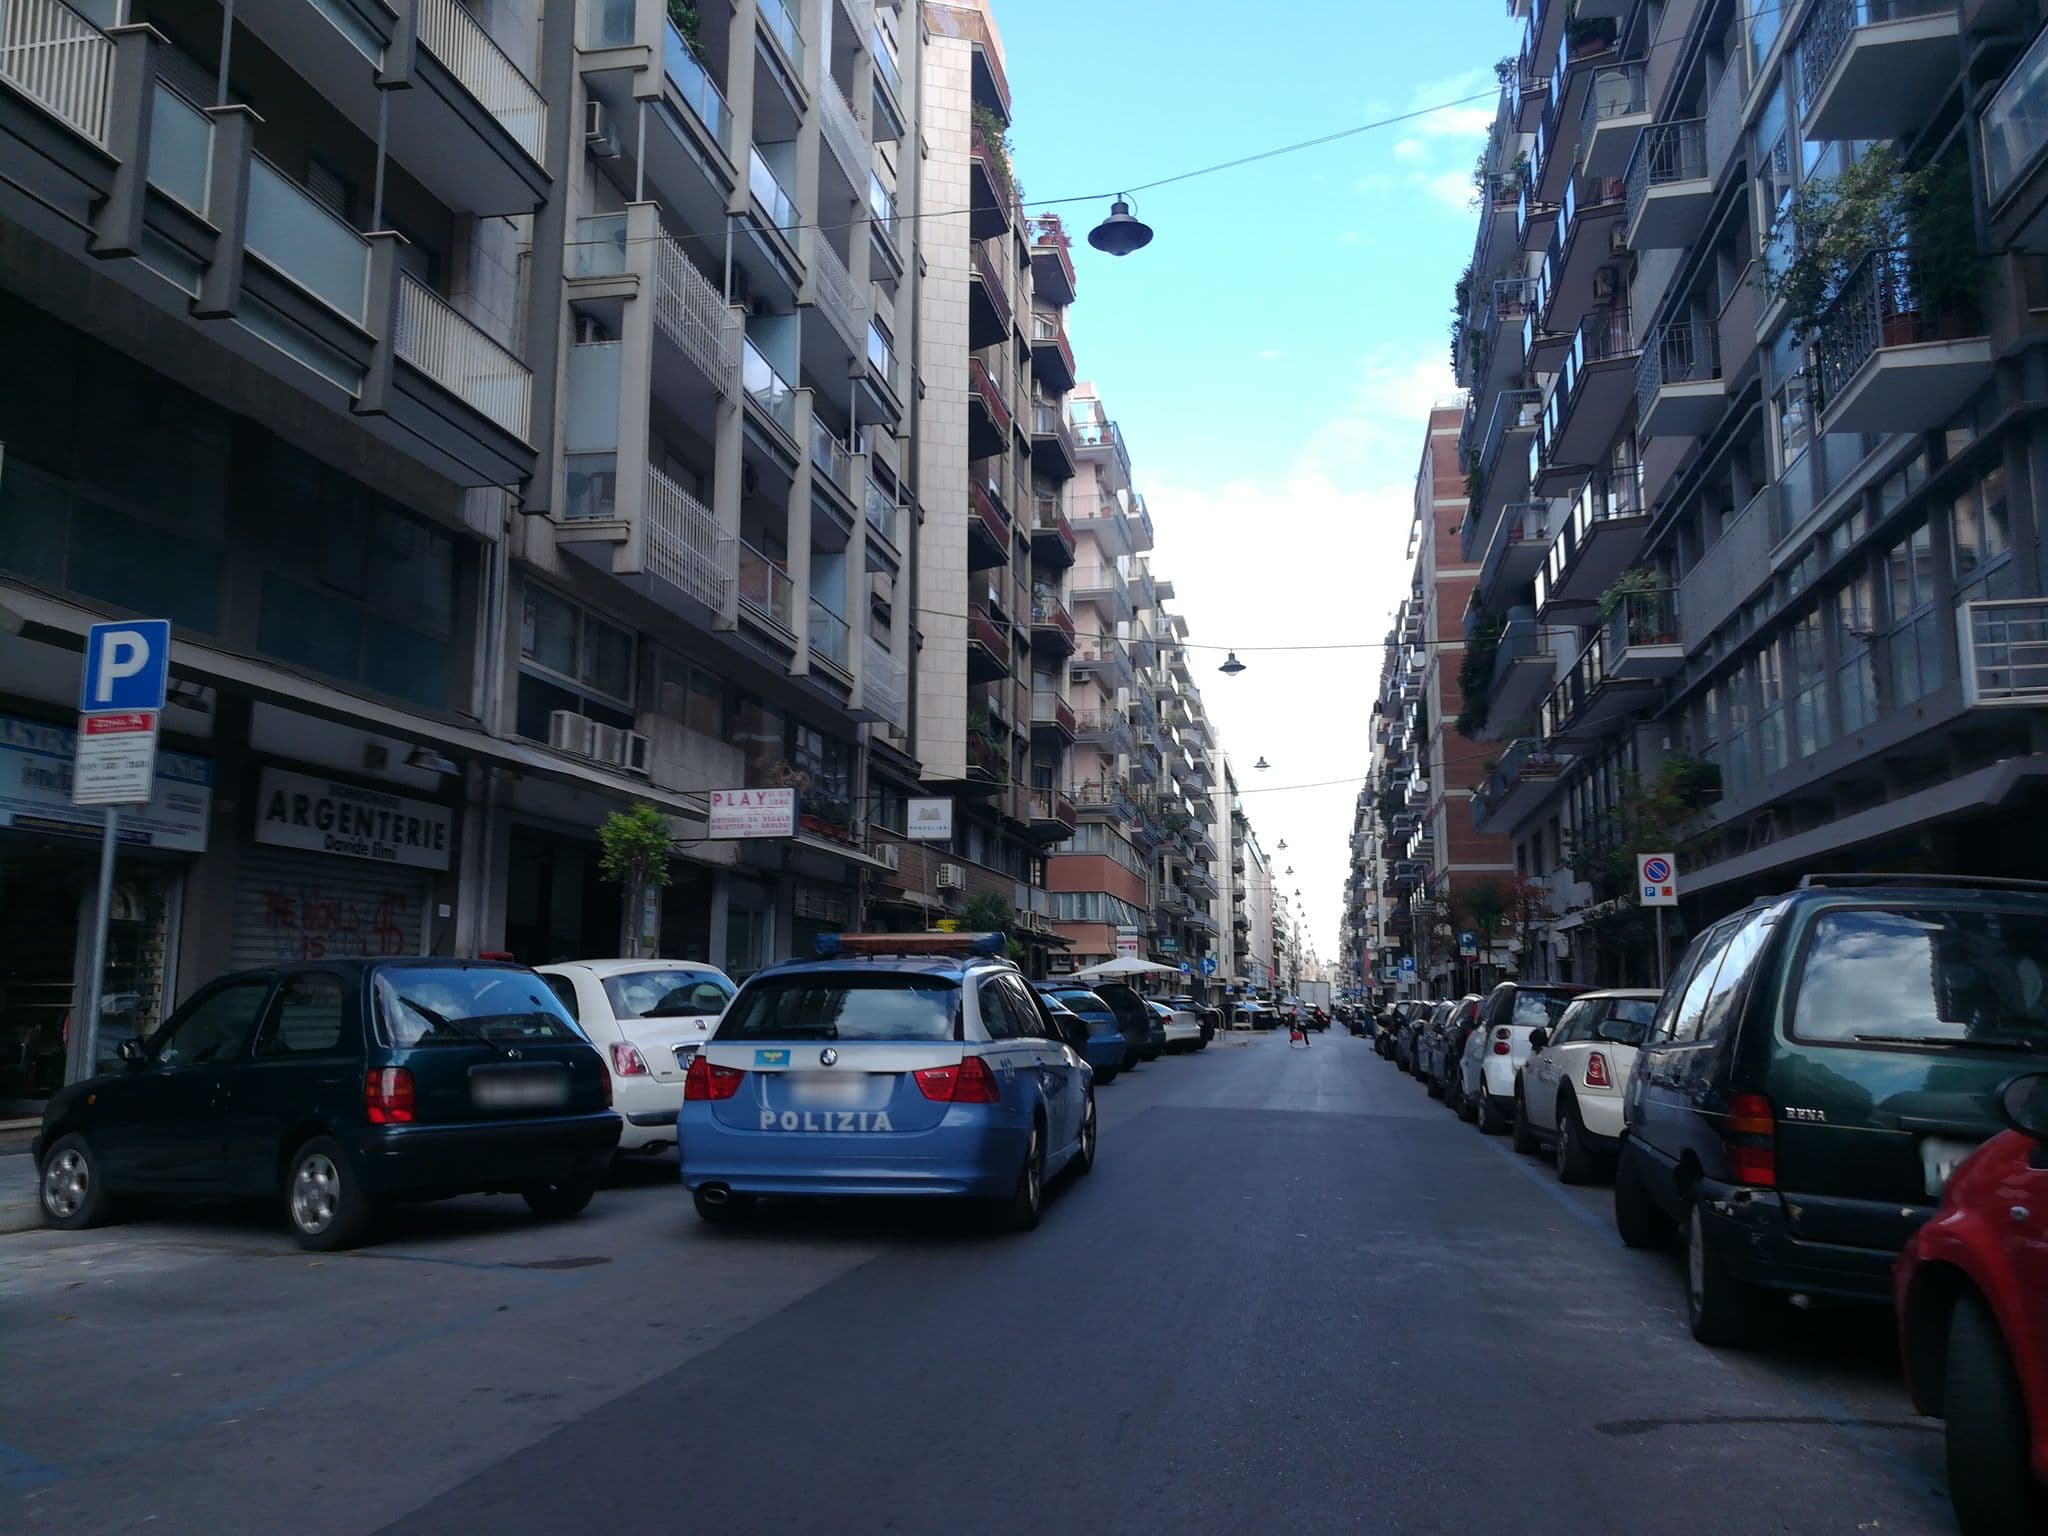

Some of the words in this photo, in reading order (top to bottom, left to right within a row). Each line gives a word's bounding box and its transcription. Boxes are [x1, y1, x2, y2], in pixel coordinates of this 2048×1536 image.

[96, 630, 150, 702] P
[265, 789, 445, 850] ARGENTERIE
[712, 791, 766, 807] PLAY
[759, 1110, 894, 1133] POLIZIA
